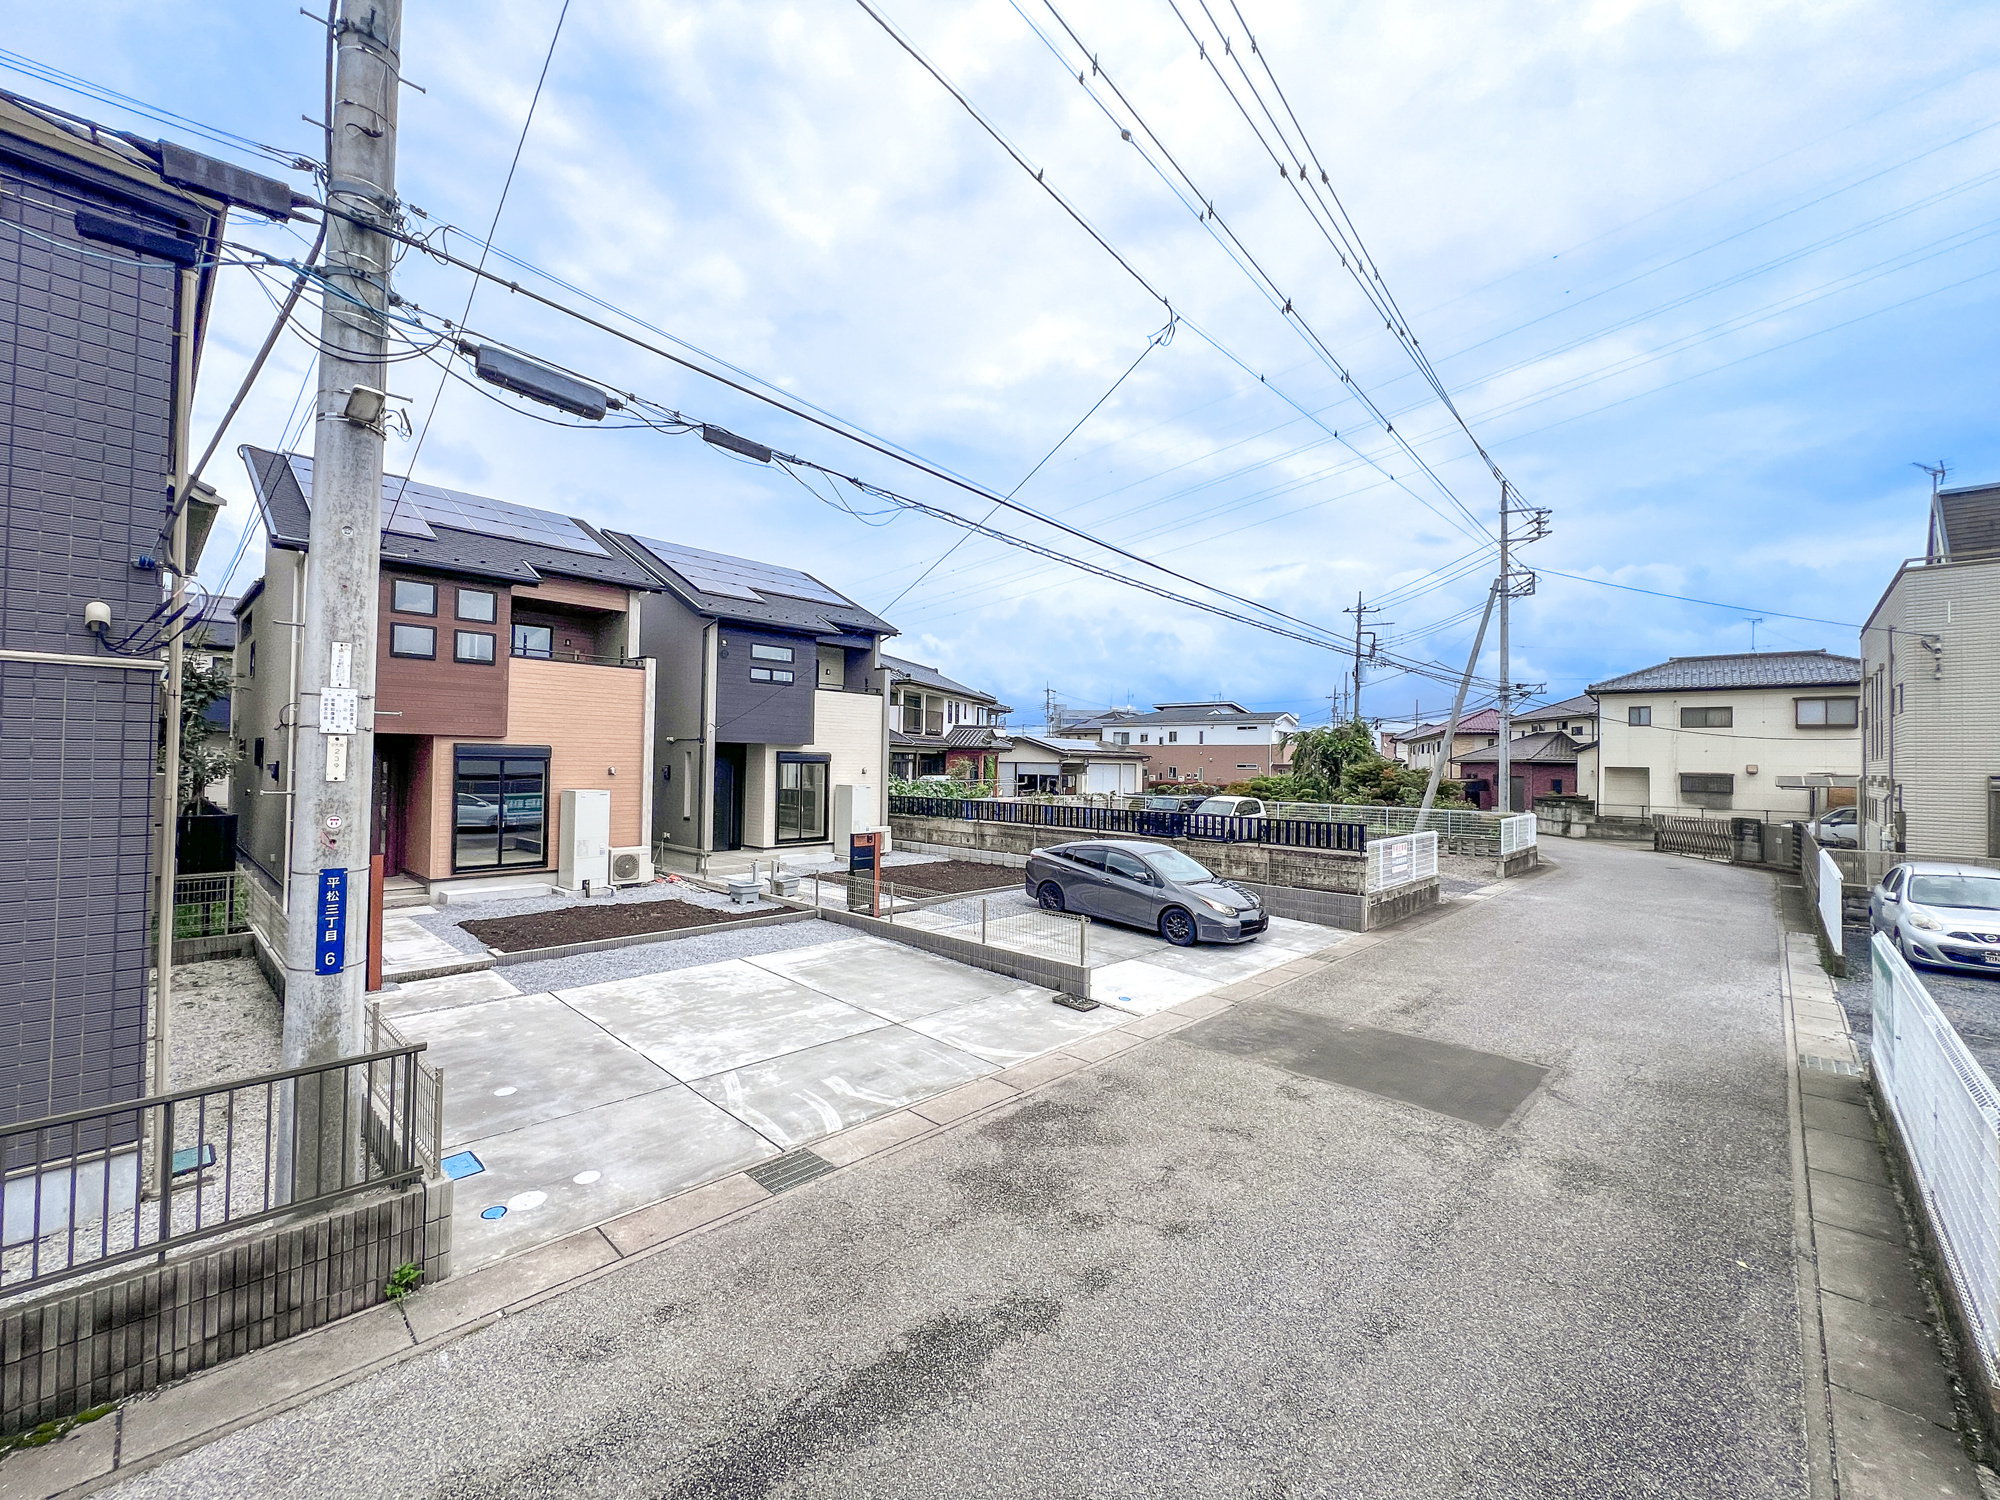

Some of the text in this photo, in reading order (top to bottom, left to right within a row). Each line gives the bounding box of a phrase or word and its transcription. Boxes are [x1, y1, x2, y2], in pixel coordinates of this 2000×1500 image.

[325, 877, 340, 966] 平松三丁目 6
